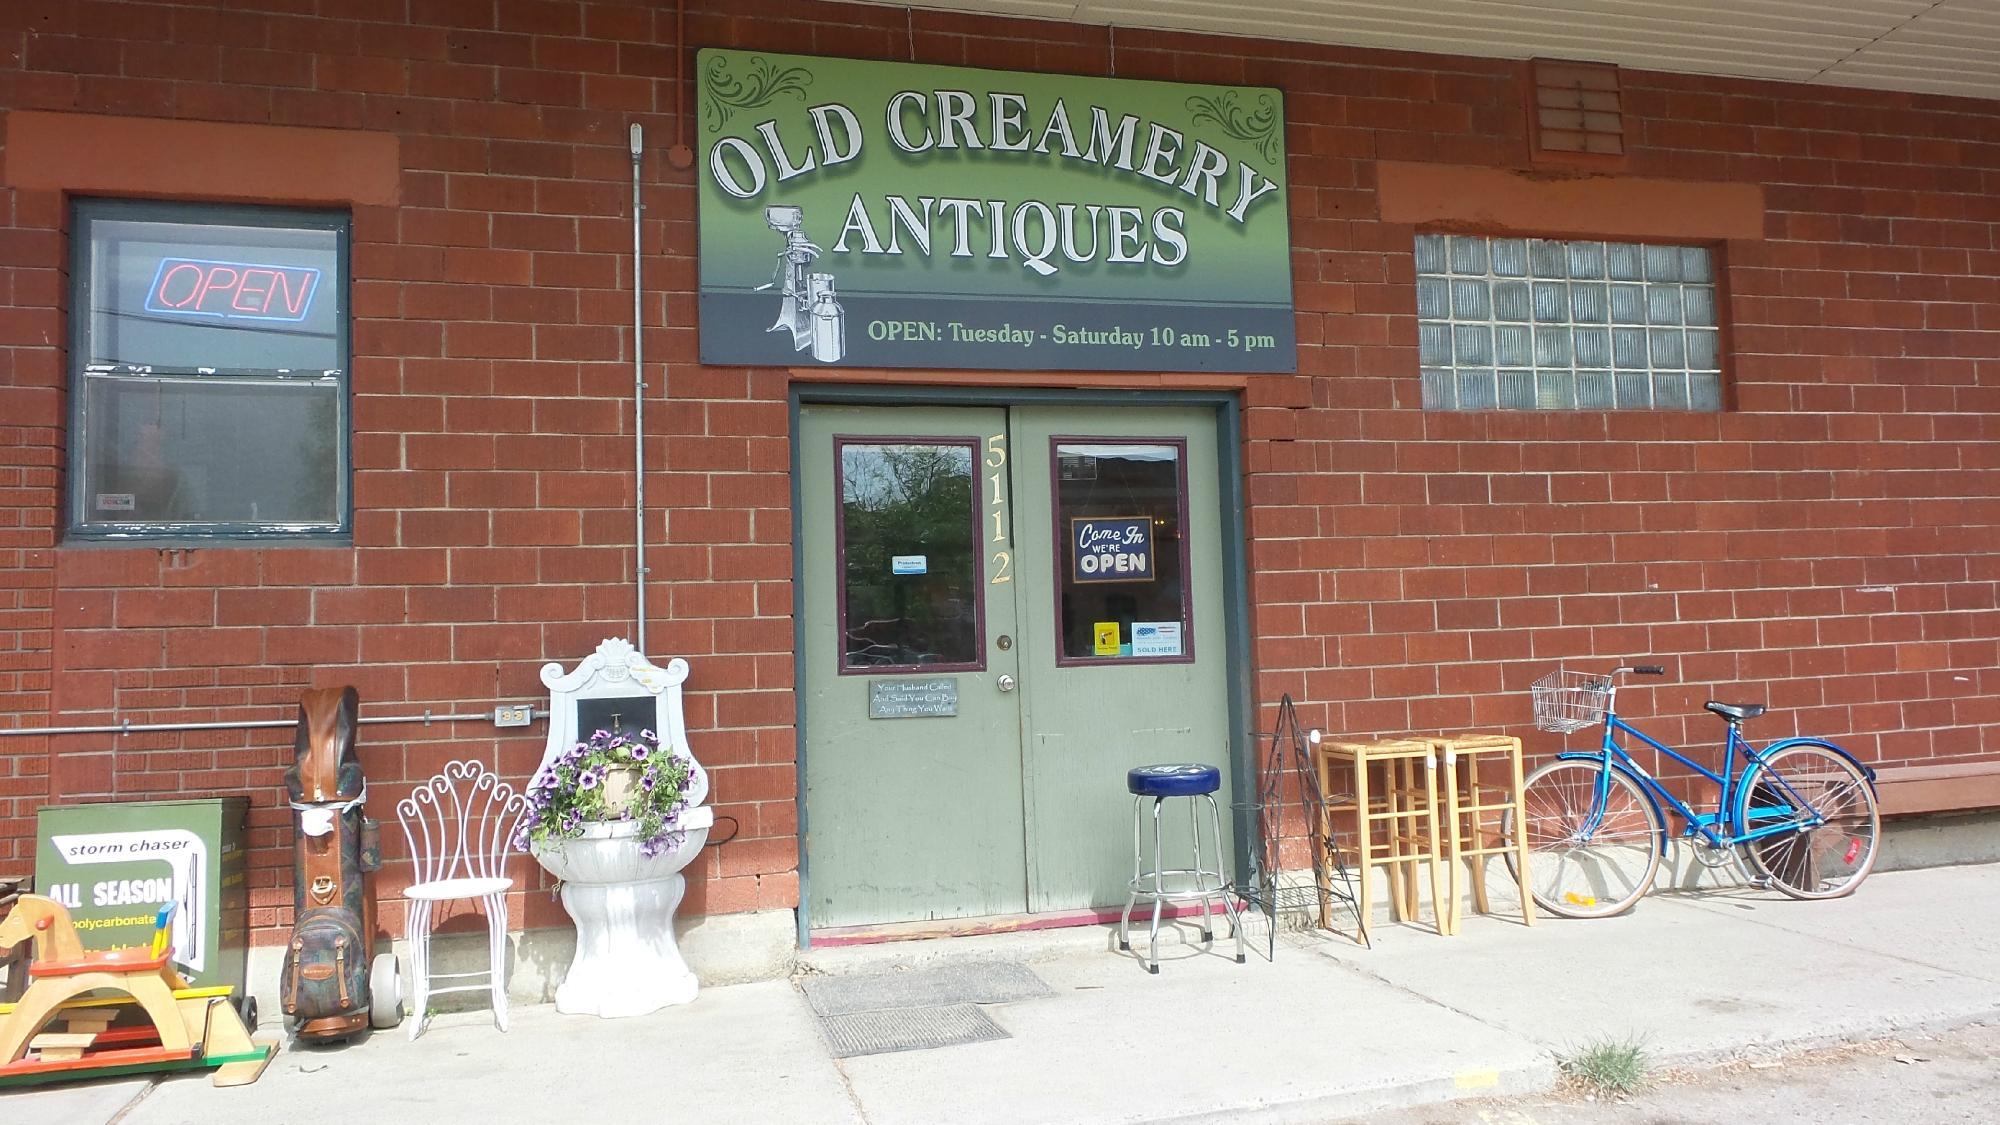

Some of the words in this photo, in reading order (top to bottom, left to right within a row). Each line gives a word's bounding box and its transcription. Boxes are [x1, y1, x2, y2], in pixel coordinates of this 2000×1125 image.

[709, 101, 864, 200] OLD
[886, 89, 1279, 225] CREAMERY
[831, 192, 1190, 276] ANTIQUES
[159, 264, 311, 314] OPEN
[867, 320, 942, 342] OPEN:
[948, 322, 1035, 347] Tuesday
[1052, 325, 1144, 350] Saturday
[1149, 327, 1175, 347] 10
[1180, 333, 1211, 347] am
[1227, 329, 1240, 348] 5
[1244, 334, 1276, 352] pm
[1080, 523, 1121, 548] Come
[1122, 526, 1145, 545] In
[1092, 544, 1121, 553] WE'RE
[1081, 553, 1146, 573] OPEN
[877, 683, 896, 691] Your
[897, 683, 928, 691] Husband
[929, 683, 952, 691] Called
[872, 694, 889, 703] And
[890, 694, 907, 702] Said
[908, 694, 924, 702] You
[925, 693, 941, 702] Can
[941, 693, 957, 704] Buy
[879, 705, 896, 714] Any
[69, 843, 123, 857] storm
[129, 839, 191, 853] chaser
[50, 883, 82, 909] ALL
[93, 878, 172, 906] SEASON
